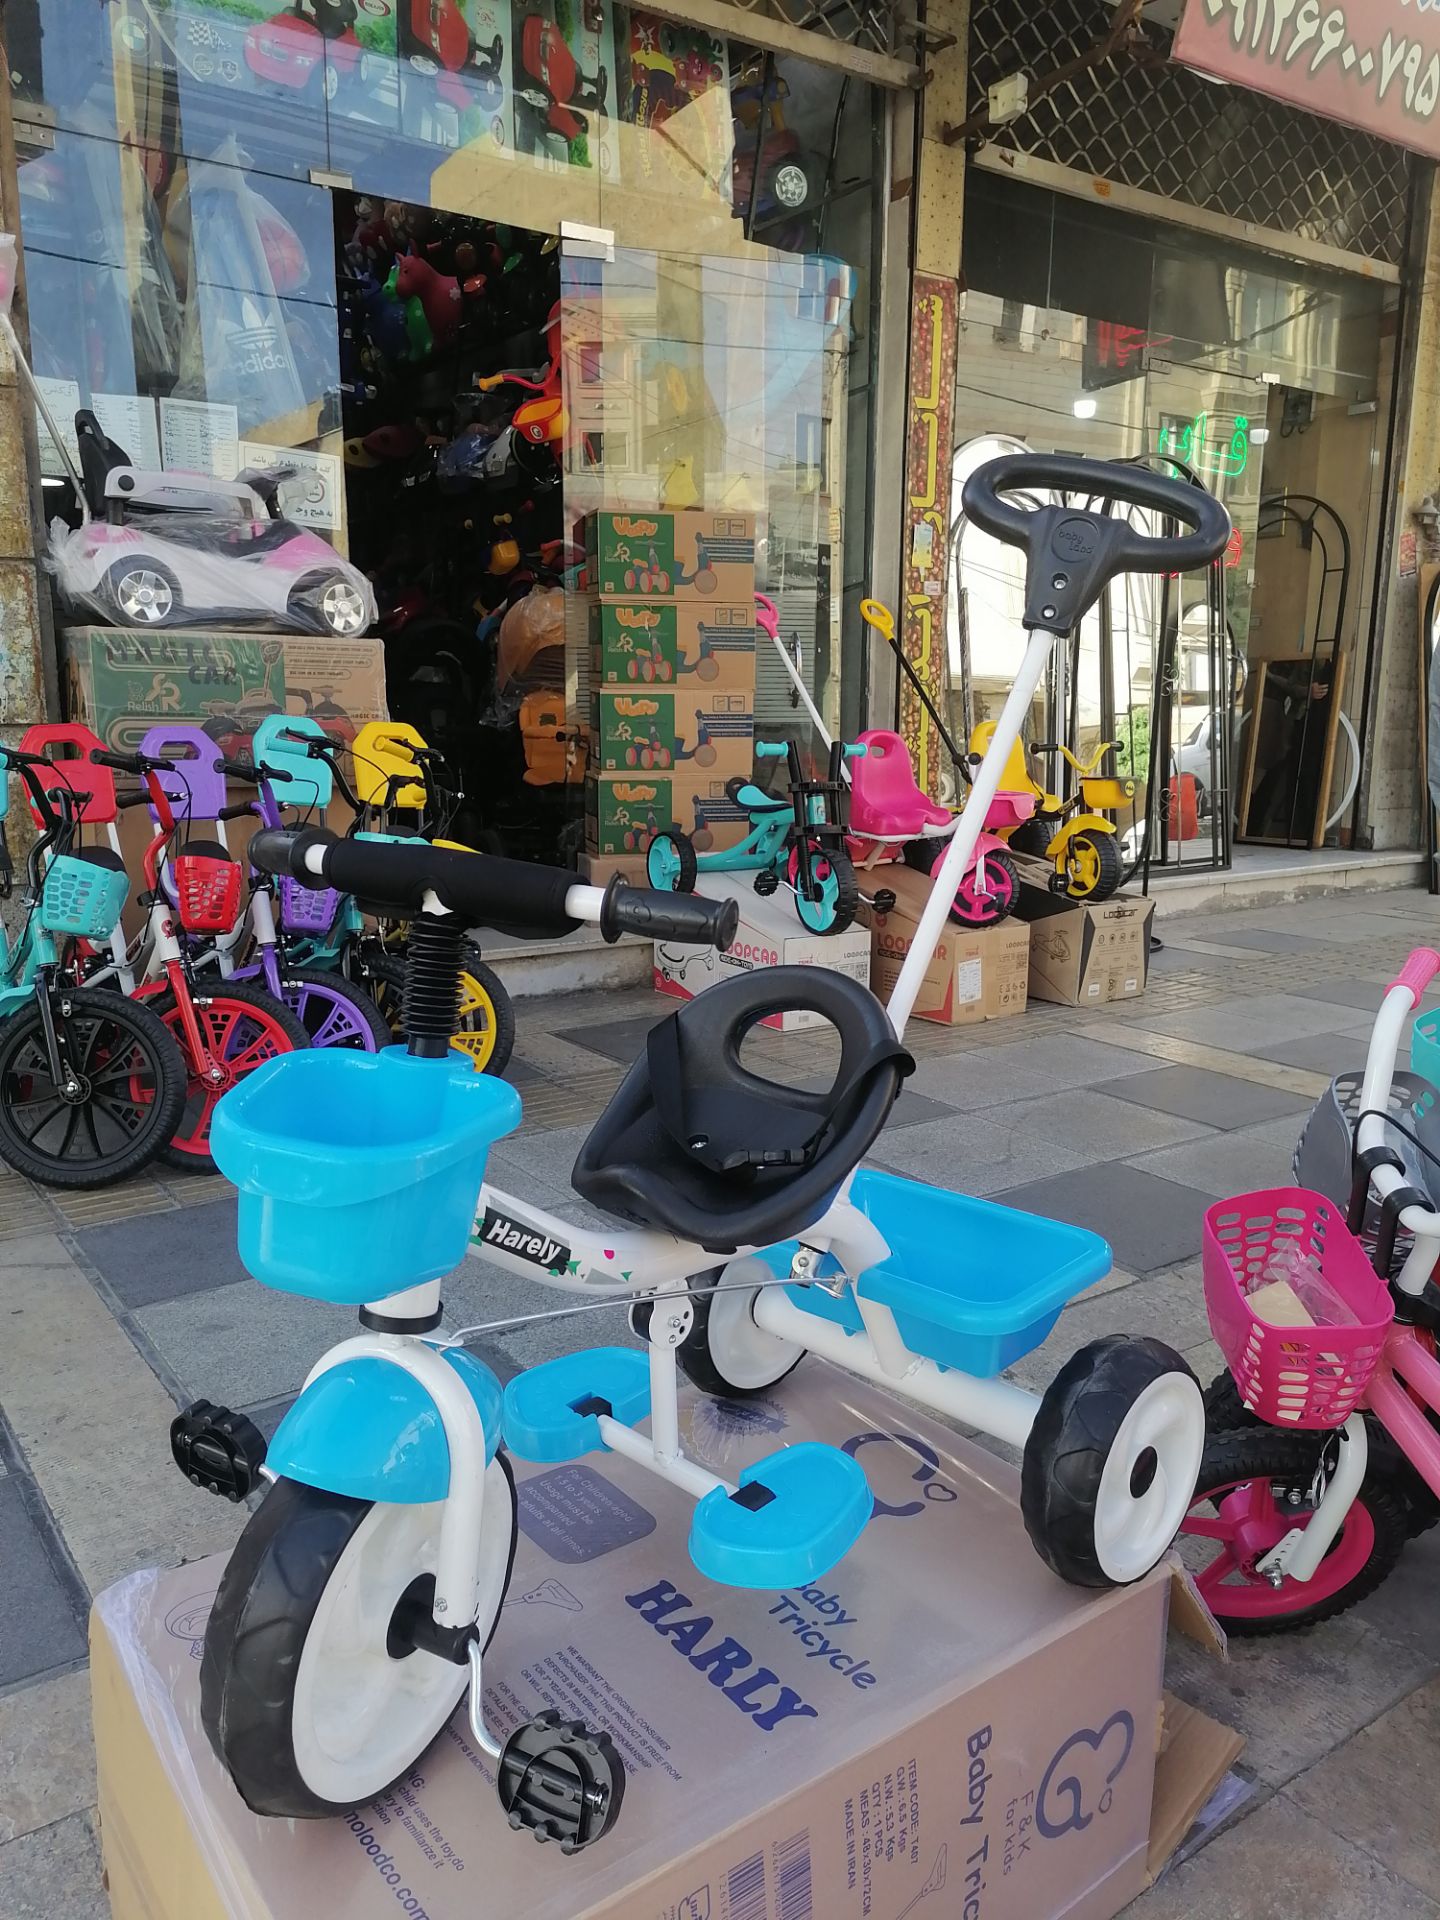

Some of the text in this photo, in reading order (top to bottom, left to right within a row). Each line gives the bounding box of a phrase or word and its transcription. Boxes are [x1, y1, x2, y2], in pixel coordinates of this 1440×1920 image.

[188, 664, 237, 685] CAR
[127, 700, 159, 711] Relish
[726, 941, 779, 966] OOPCAR
[486, 1219, 562, 1264] Harely
[524, 1486, 573, 1526] accompanied
[538, 1480, 566, 1500] Usage
[520, 1499, 545, 1519] adults
[552, 1526, 563, 1535] all
[625, 1580, 818, 1731] HARLY
[769, 1594, 877, 1690] Tricycle
[498, 1682, 510, 1694] FOR
[509, 1694, 520, 1705] THE
[522, 1670, 531, 1679] OR
[530, 1679, 543, 1691] WILL
[533, 1664, 545, 1675] FOR
[549, 1681, 568, 1699] YEARS
[566, 1700, 584, 1717] FROM
[582, 1717, 597, 1731] DATE
[567, 1646, 577, 1655] WE
[576, 1655, 602, 1681] WARRANT
[602, 1682, 614, 1693] THE
[637, 1718, 669, 1750] CONSUMER
[506, 1711, 518, 1723] AND
[544, 1657, 569, 1681] DEFECTS
[573, 1688, 601, 1715] MATERIAL
[599, 1715, 609, 1724] OR
[607, 1724, 651, 1768] WORKMANSHIP
[556, 1652, 589, 1684] PURCHASER
[587, 1684, 601, 1698] THAT
[600, 1698, 614, 1711] THIS
[614, 1712, 641, 1739] PRODUCT
[646, 1745, 664, 1762] FREE
[662, 1762, 682, 1780] FROM
[884, 1773, 894, 1804] N.W.
[908, 1758, 918, 1792] ITEM
[859, 1789, 870, 1830] MEAS
[872, 1782, 882, 1808] QTY
[910, 1793, 919, 1835] CODE:
[394, 1806, 405, 1817] to
[401, 1816, 437, 1861] familiarize
[433, 1859, 445, 1869] it
[415, 1807, 434, 1828] uses
[429, 1826, 444, 1843] the
[898, 1828, 908, 1854] Kgs
[960, 1725, 993, 1920] Baby Tric
[1003, 1798, 1018, 1876] for kids
[1016, 1789, 1034, 1860] F & K
[844, 1799, 857, 1890] MADE IN IRAN
[874, 1829, 884, 1858] PCS
[885, 1836, 896, 1862] Kgs
